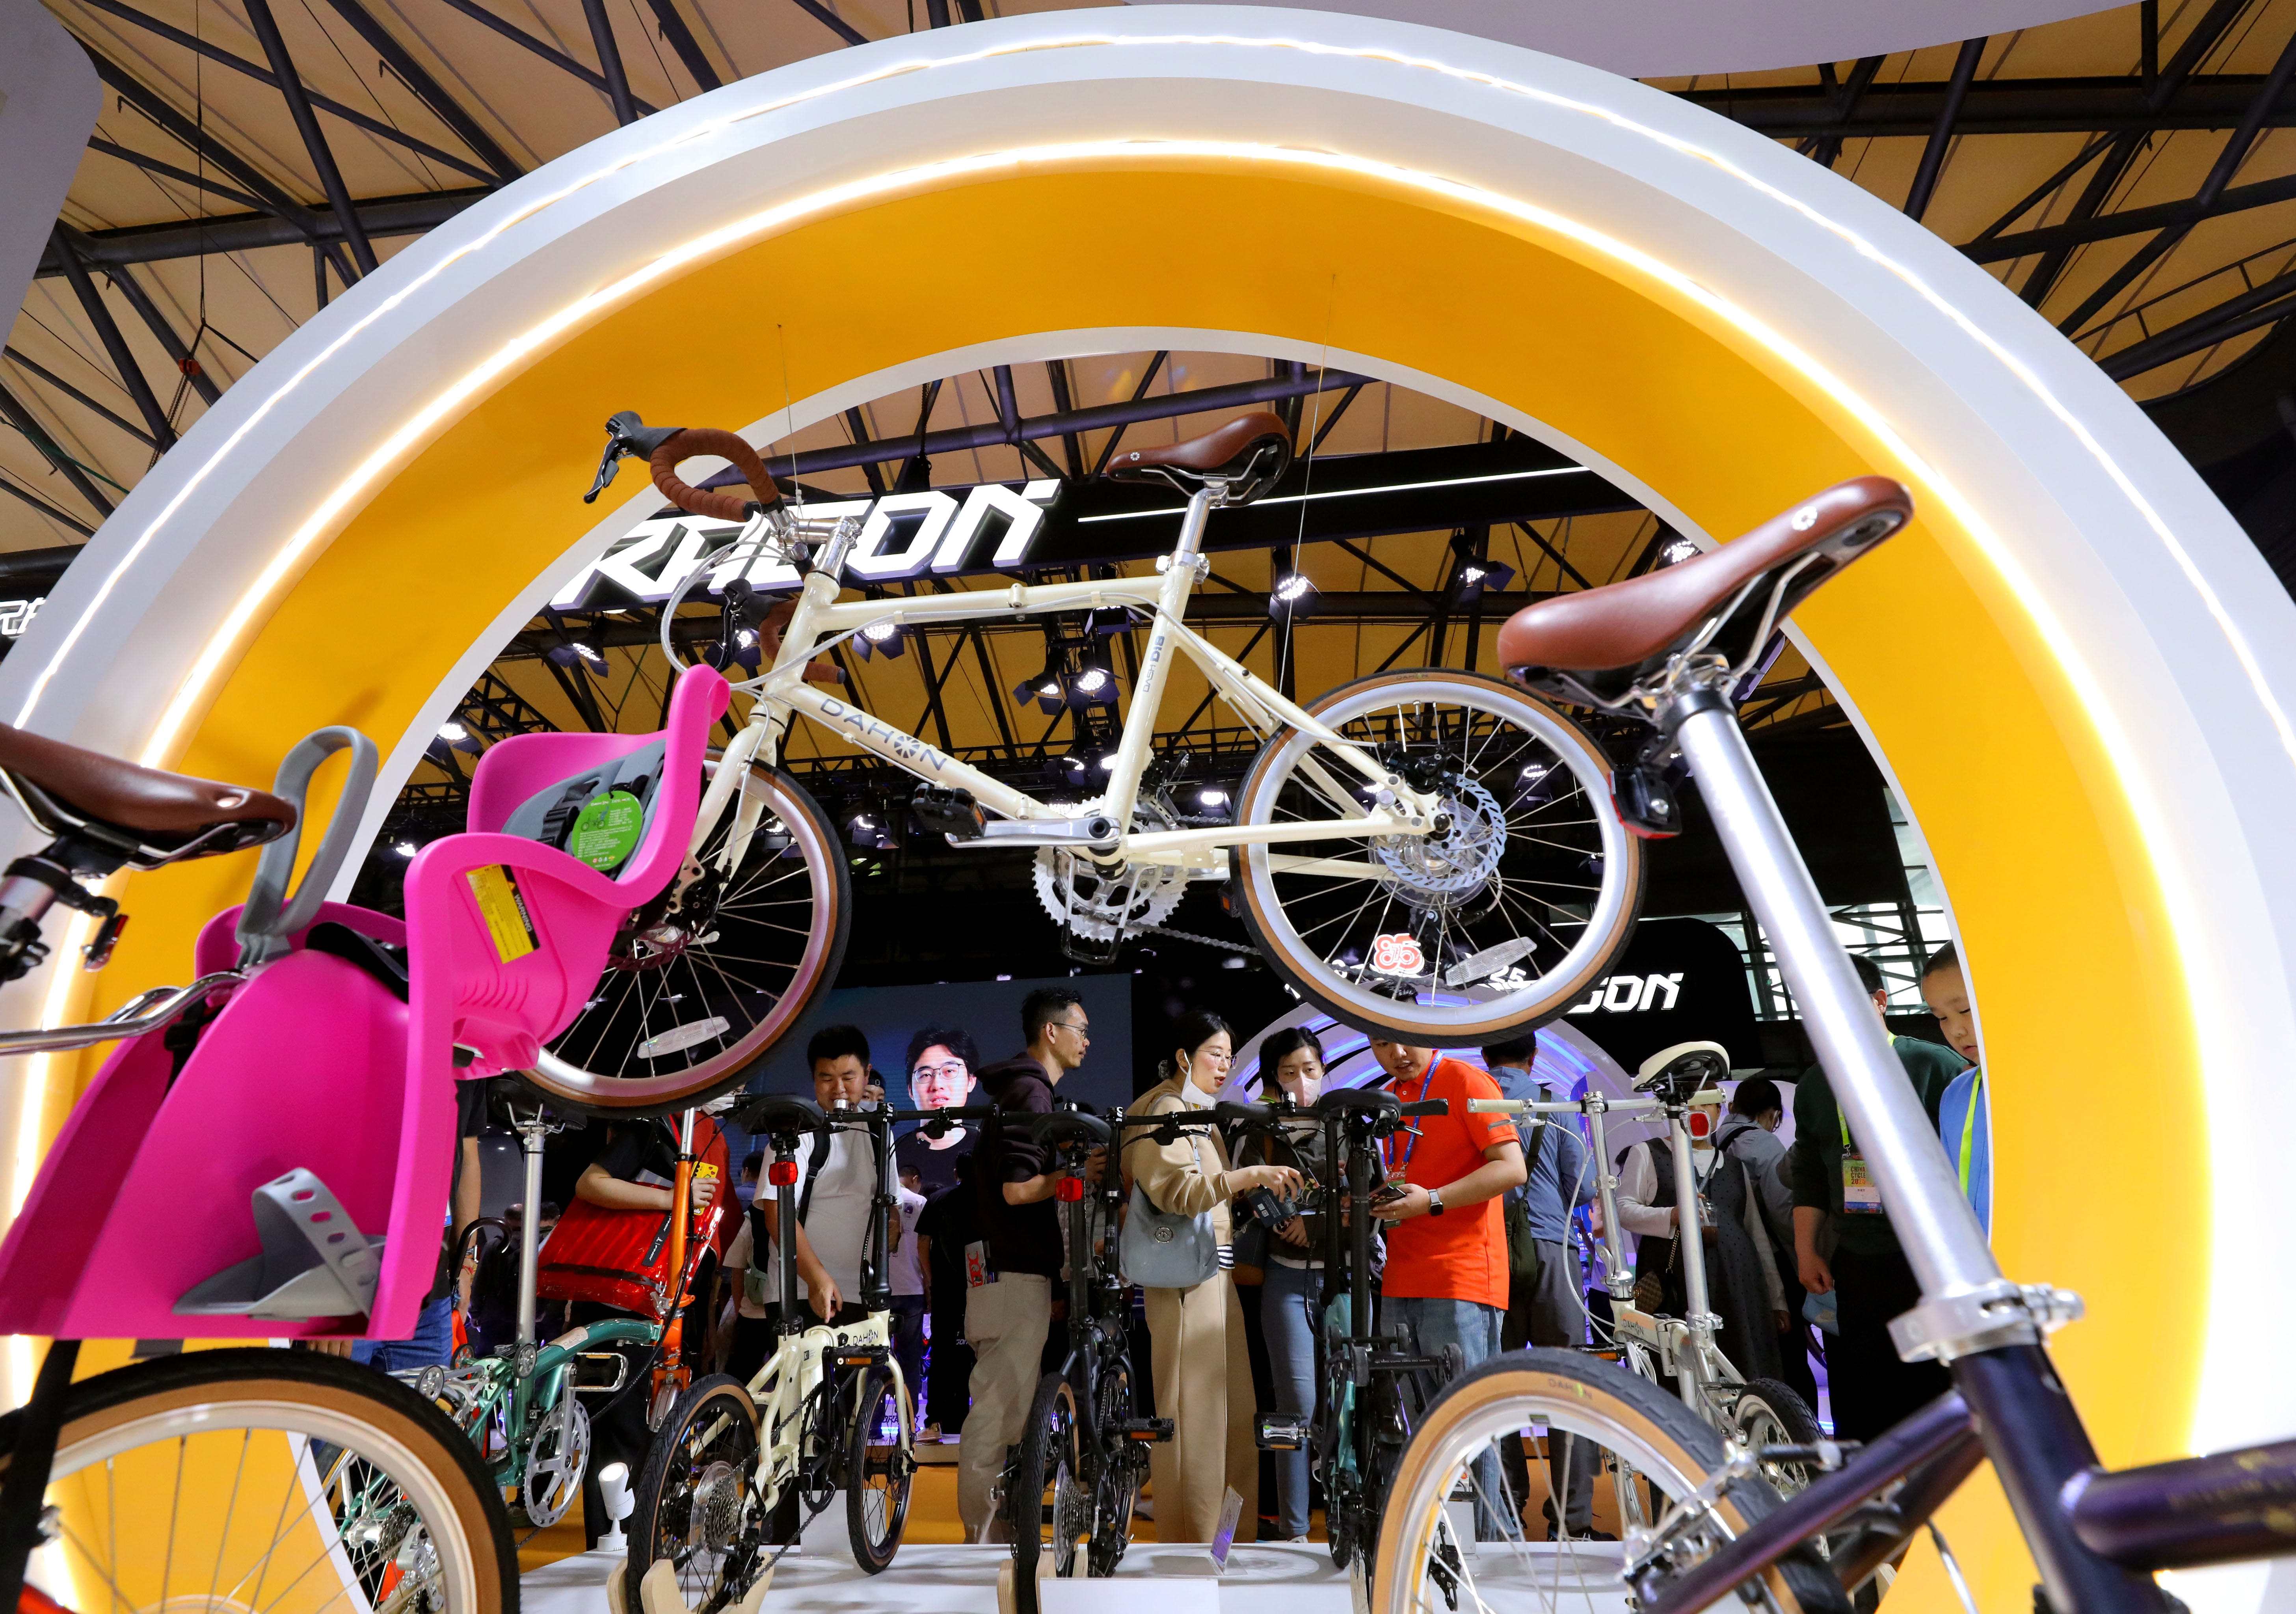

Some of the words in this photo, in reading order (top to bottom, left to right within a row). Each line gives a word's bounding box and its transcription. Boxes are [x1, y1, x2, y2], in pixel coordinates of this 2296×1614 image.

[820, 698, 947, 771] DAHON
[514, 894, 532, 932] WARNING
[853, 1329, 878, 1345] DAHON
